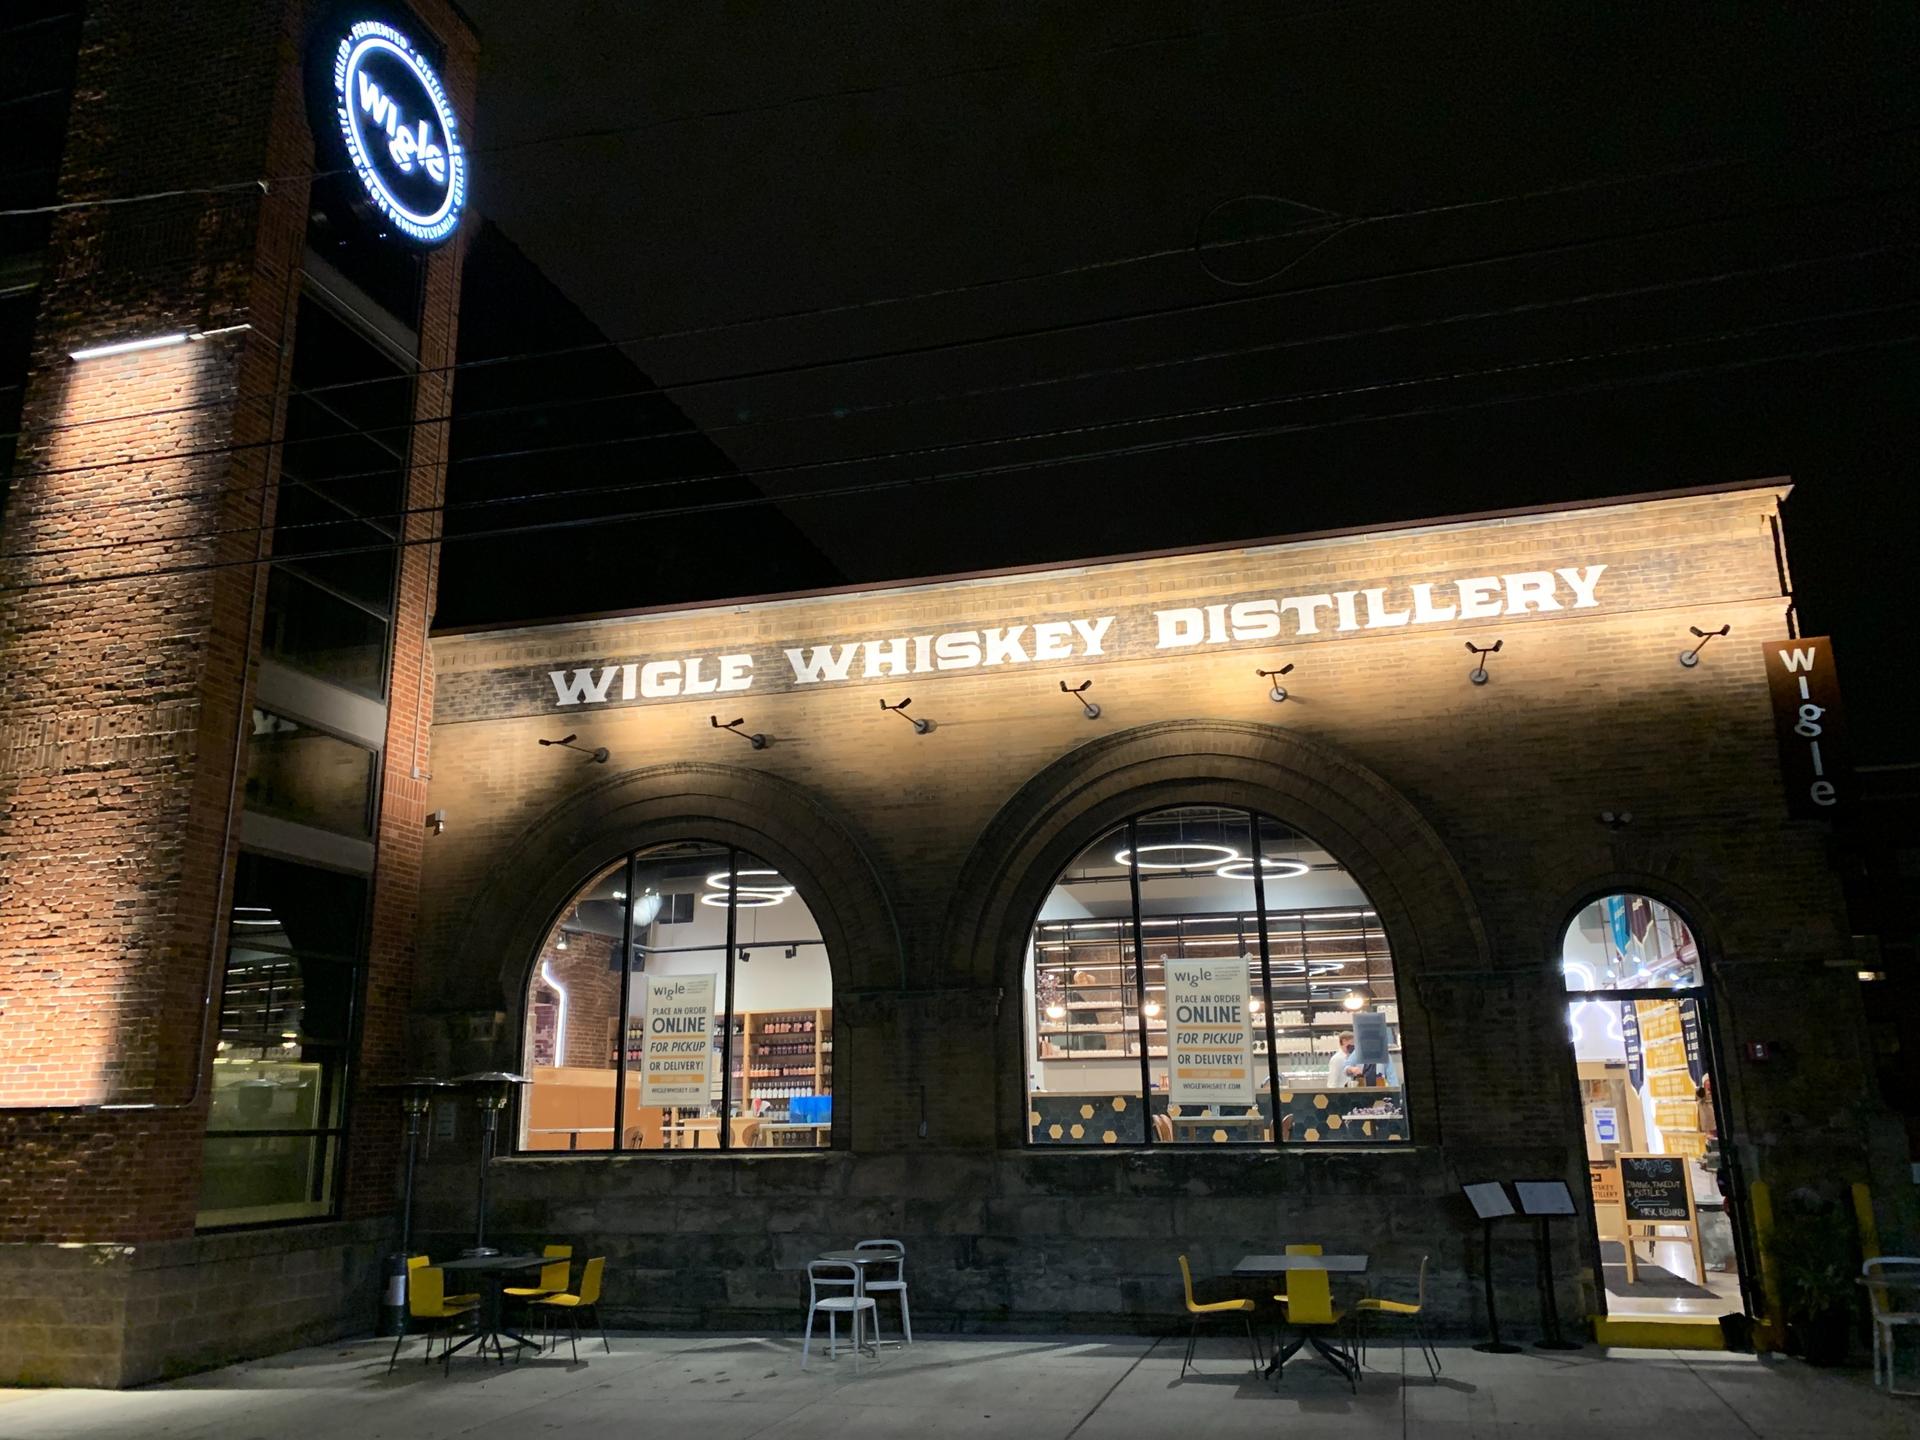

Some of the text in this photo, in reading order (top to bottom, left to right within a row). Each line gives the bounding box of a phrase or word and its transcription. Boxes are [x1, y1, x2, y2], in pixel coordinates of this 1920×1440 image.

[335, 21, 464, 206] MILLED FERMENTED DISTILLED BOTTLED
[389, 207, 456, 239] PENNSYLVANIA
[549, 564, 1609, 706] WIGLE WHISKEY DISTILLERY
[1175, 968, 1212, 988] wigle
[654, 982, 686, 1000] wigle
[1175, 994, 1241, 1003] PLACE AN ORDER
[652, 1006, 707, 1016] PLACE AN ORDER
[1176, 1005, 1241, 1023] ONLINE
[652, 1017, 706, 1033] ONLINE
[1176, 1032, 1244, 1044] FOR PICKUP
[650, 1041, 706, 1052] FOR PICKUP
[649, 1061, 704, 1071] OR DELIVERY!
[1178, 1054, 1243, 1065] OR DELIVERY!
